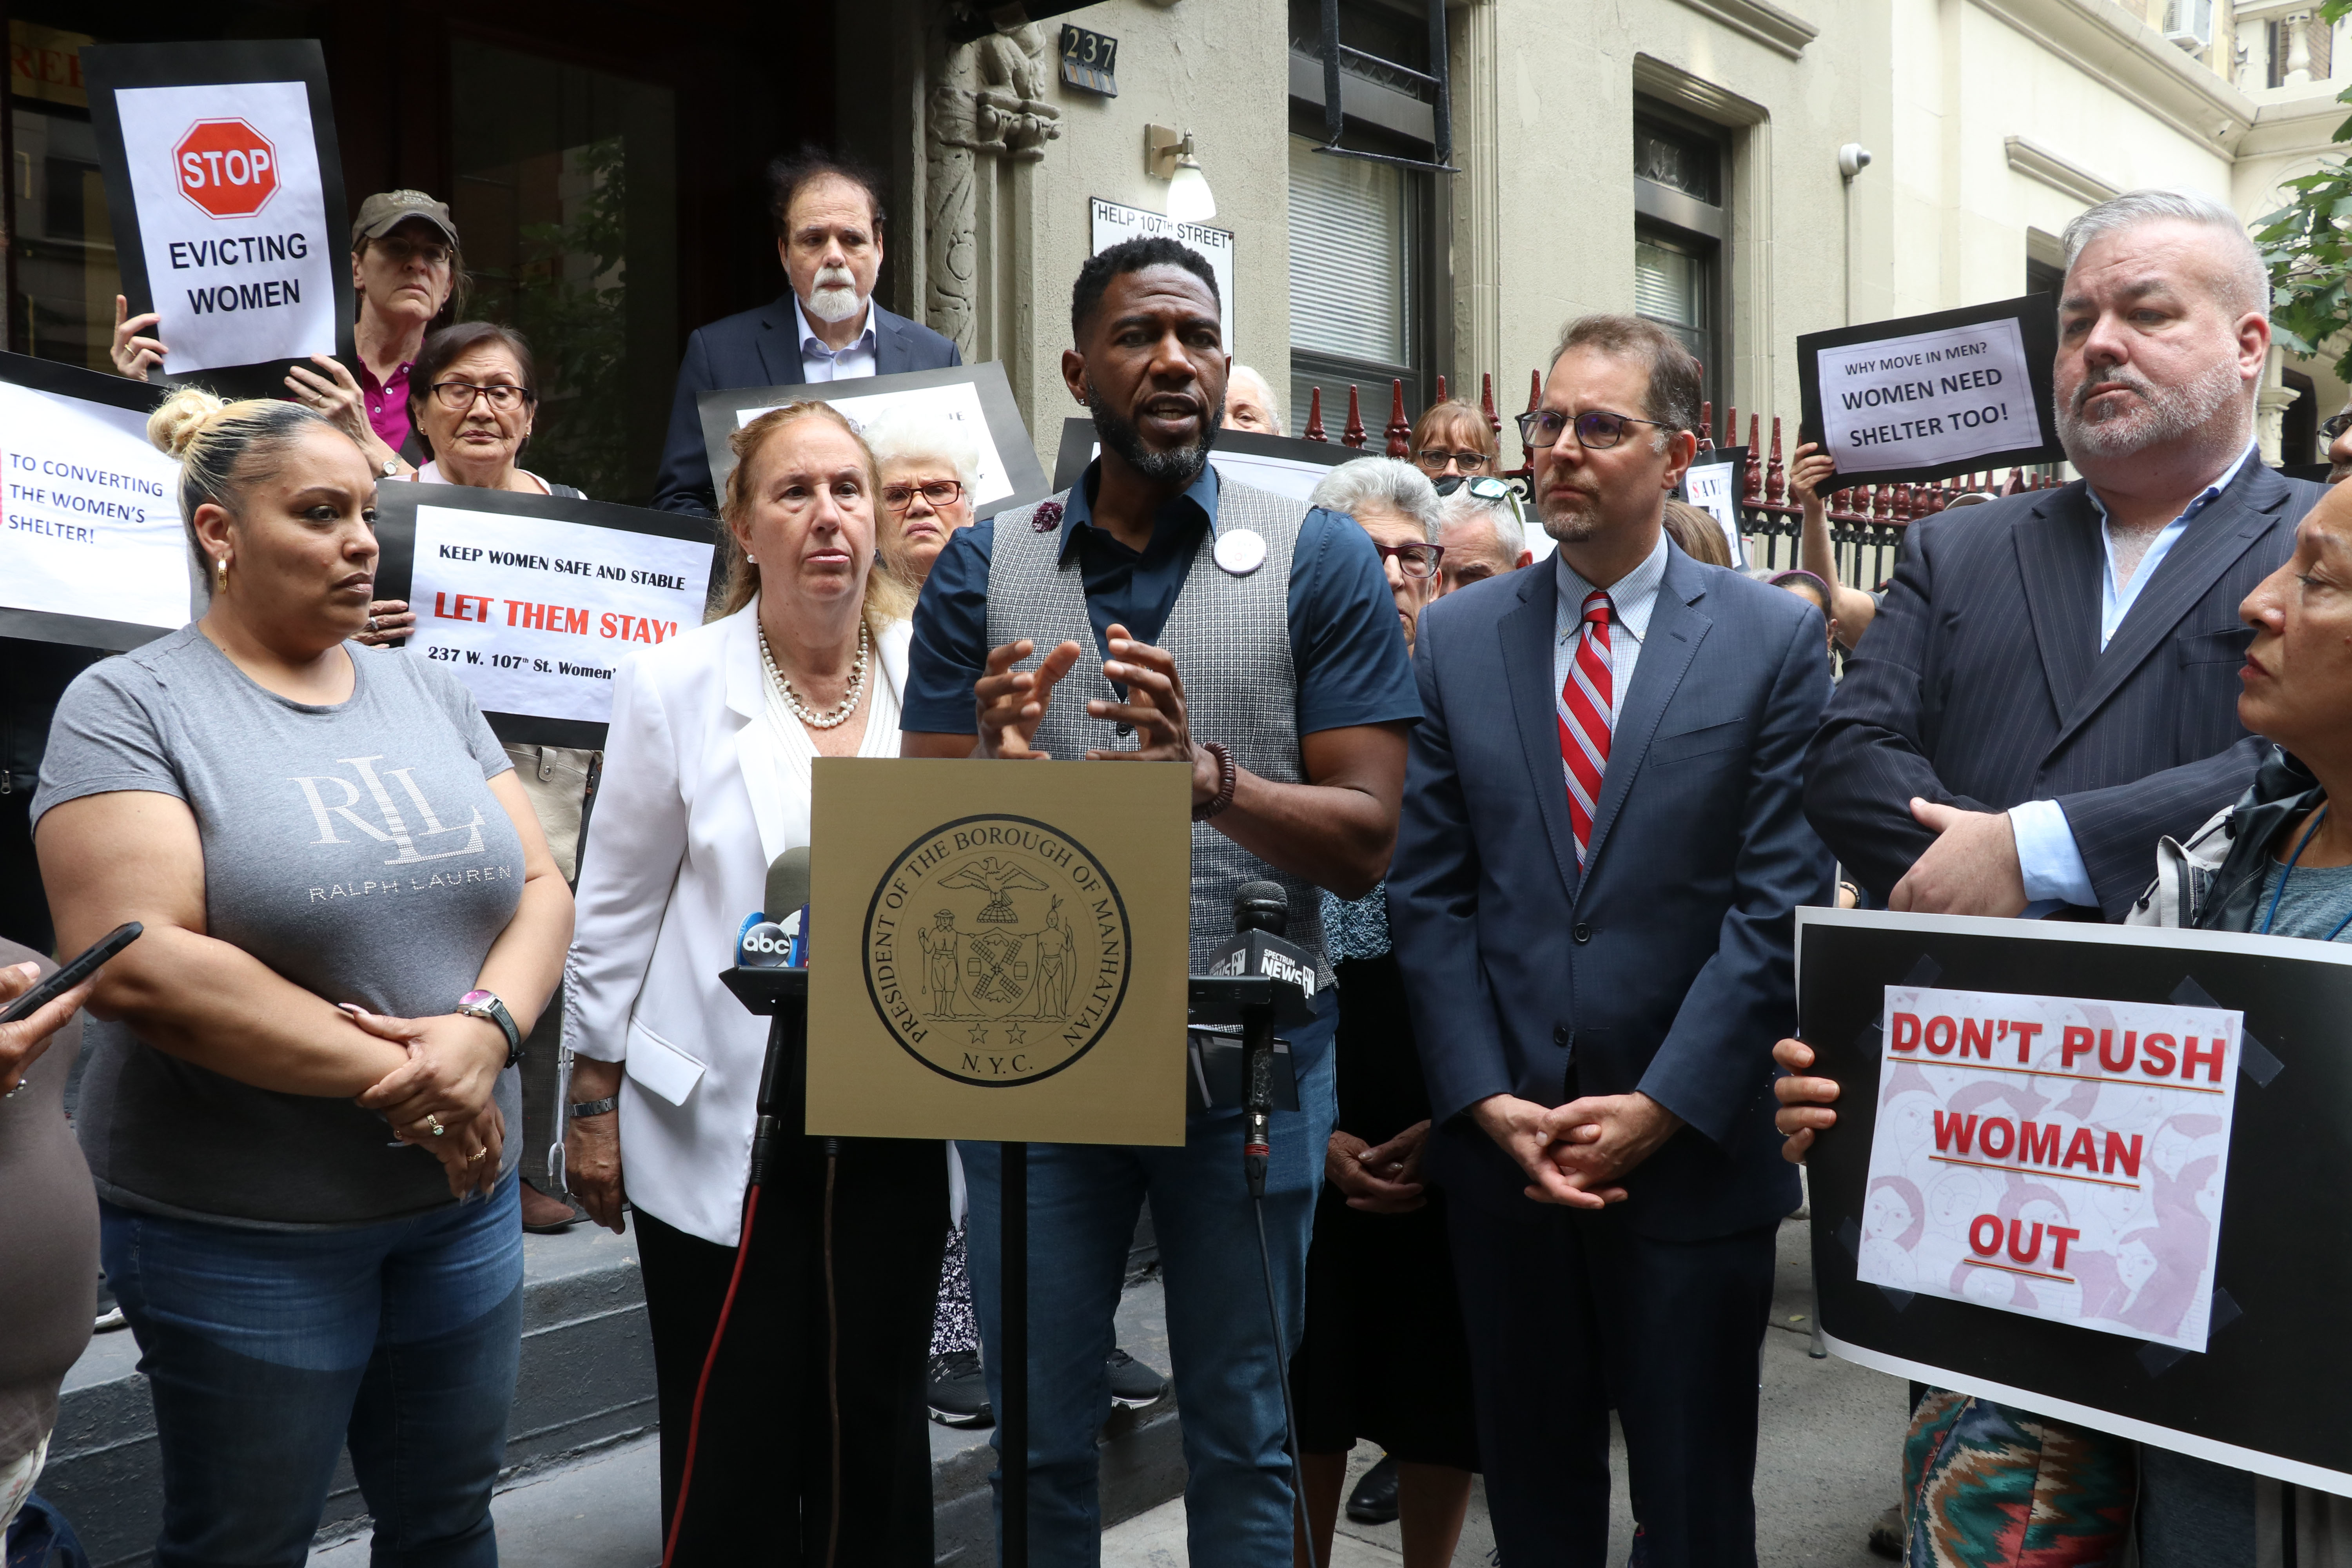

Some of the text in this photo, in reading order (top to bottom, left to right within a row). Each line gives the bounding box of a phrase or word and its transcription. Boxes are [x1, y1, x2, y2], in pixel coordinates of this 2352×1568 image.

[1066, 28, 1116, 67] 237
[182, 149, 270, 188] STOP
[1098, 203, 1228, 249] HELP 107TH STREET
[169, 233, 307, 269] EVICTING
[187, 279, 300, 314] WOMEN
[1845, 342, 1987, 375] WHY MOVE IN MEN?
[1842, 368, 2002, 410] WOMEN NEED
[1850, 403, 2009, 448] SHELTER TOO!
[10, 453, 163, 497] TO CONVERTING
[9, 484, 145, 523] THE WOMEN'S
[8, 514, 94, 544] SHELTER!
[439, 544, 686, 591] KEEP WOMEN SAFE AND STABLE
[434, 591, 677, 644] LET THEM STAY!
[428, 646, 461, 662] 237
[466, 650, 484, 665] W.
[491, 653, 529, 669] 107th
[533, 659, 552, 673] St.
[309, 865, 510, 902] RALPH LAUREN
[742, 932, 790, 955] abc
[875, 827, 1120, 1047] PRESIDENT OF THE BOROUGH OF MANHATTAN
[1234, 951, 1244, 964] NY
[1260, 956, 1303, 985] NEWS
[1263, 948, 1295, 967] SPECTRUM
[1891, 1011, 2226, 1083] DON'T PUSH
[1933, 1108, 2143, 1178] WOMAN
[1968, 1212, 2080, 1271] OUT
